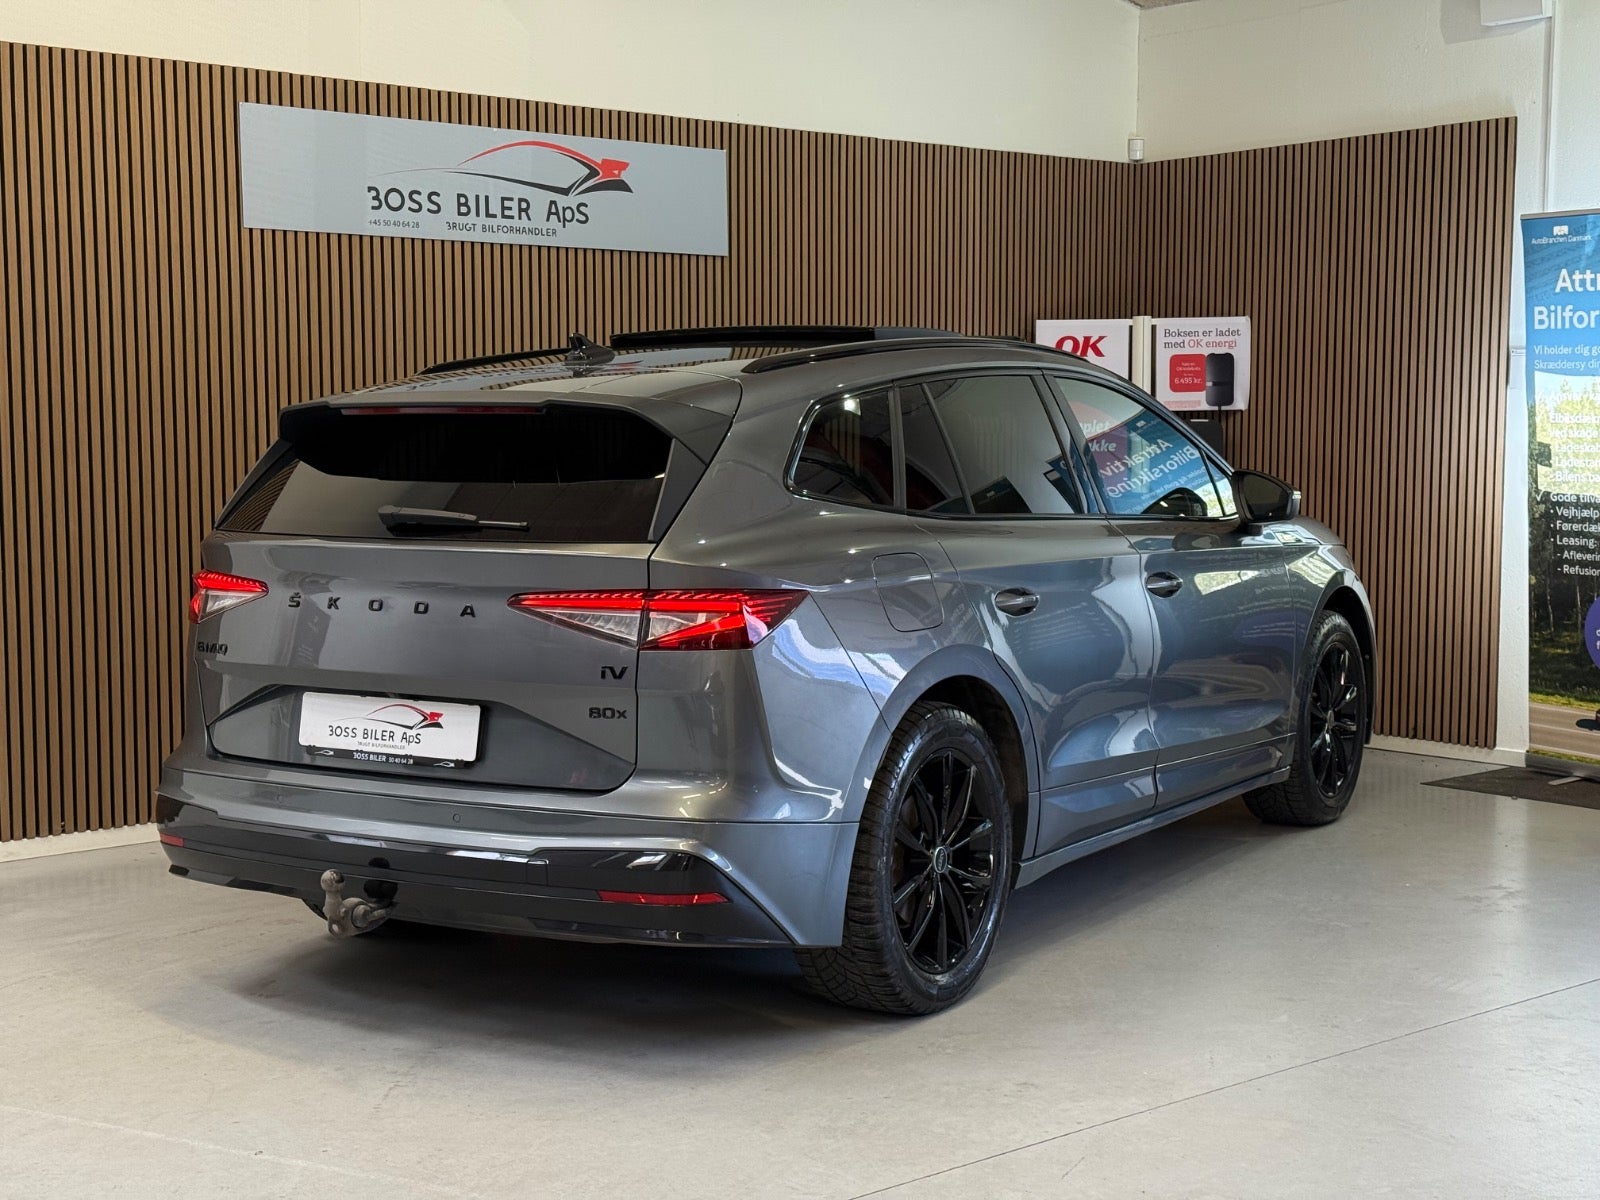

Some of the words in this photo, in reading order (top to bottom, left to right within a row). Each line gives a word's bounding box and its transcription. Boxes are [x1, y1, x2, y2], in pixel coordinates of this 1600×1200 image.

[456, 193, 532, 221] BILER
[545, 199, 590, 228] ApS
[382, 219, 391, 227] 50
[392, 220, 401, 228] 40
[411, 221, 420, 229] 28
[481, 223, 557, 238] BILFORHANDLER
[1533, 304, 1600, 330] Bilfor
[1163, 328, 1200, 338] Boksen
[1215, 327, 1242, 337] ladet
[1055, 335, 1108, 358] OK
[1163, 340, 1186, 349] med
[1187, 339, 1204, 348] OK
[1205, 339, 1237, 350] energi
[1544, 344, 1572, 355] holder
[1575, 344, 1590, 357] dig
[1534, 359, 1586, 372] Skræddersy
[1550, 492, 1577, 503] Gode
[1555, 506, 1600, 520] Vejhjælp
[1556, 534, 1598, 549] Leasing:
[362, 728, 395, 742] BILER
[401, 732, 422, 746] ApS
[369, 753, 387, 763] BILER
